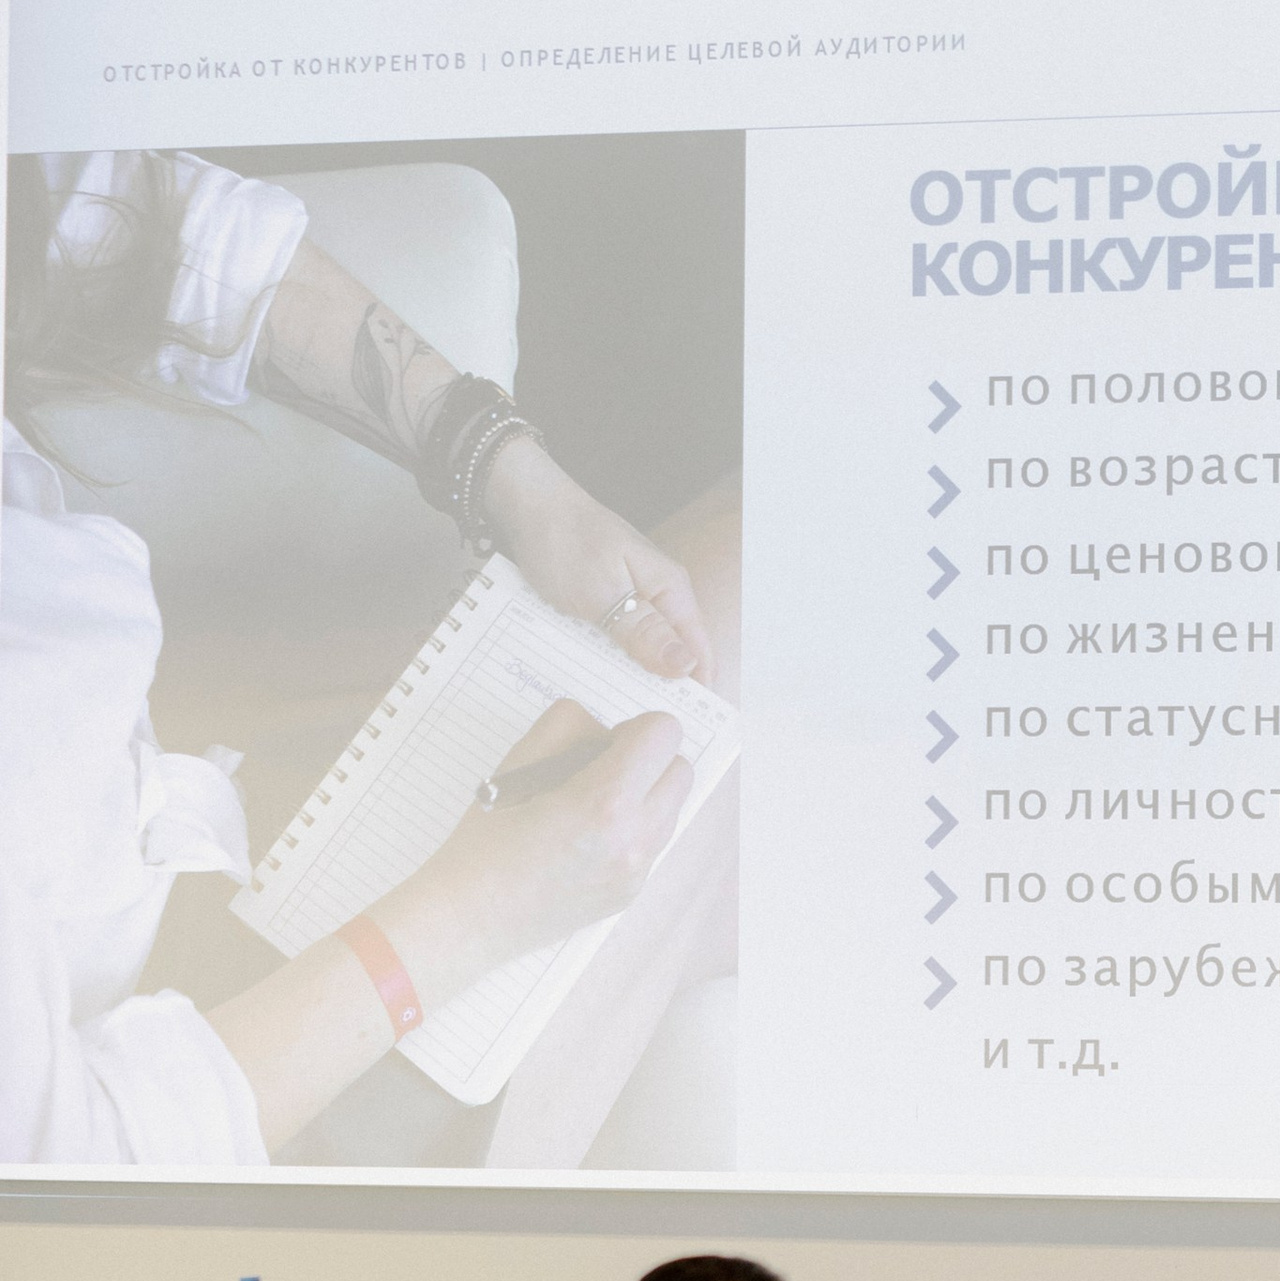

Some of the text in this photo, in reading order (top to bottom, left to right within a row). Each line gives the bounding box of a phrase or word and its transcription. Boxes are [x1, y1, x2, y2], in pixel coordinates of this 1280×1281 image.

[102, 57, 242, 83] ОТСТРОЙКА
[251, 59, 284, 78] ОТ
[293, 51, 467, 76] КОНКУРЕНТОВ
[500, 45, 677, 69] ОПРЕДЕЛЕНИЕ
[687, 35, 802, 65] ЦЕЛЕВОЙ
[814, 33, 967, 60] АУДИТОРИИ
[987, 373, 1051, 408] по
[986, 456, 1051, 490] по
[986, 543, 1050, 577] по
[985, 622, 1049, 656] по
[985, 705, 1049, 738] по
[984, 788, 1048, 821] по
[984, 871, 1048, 904] по
[983, 954, 1047, 988] по
[982, 1037, 1121, 1078] и т.д.
